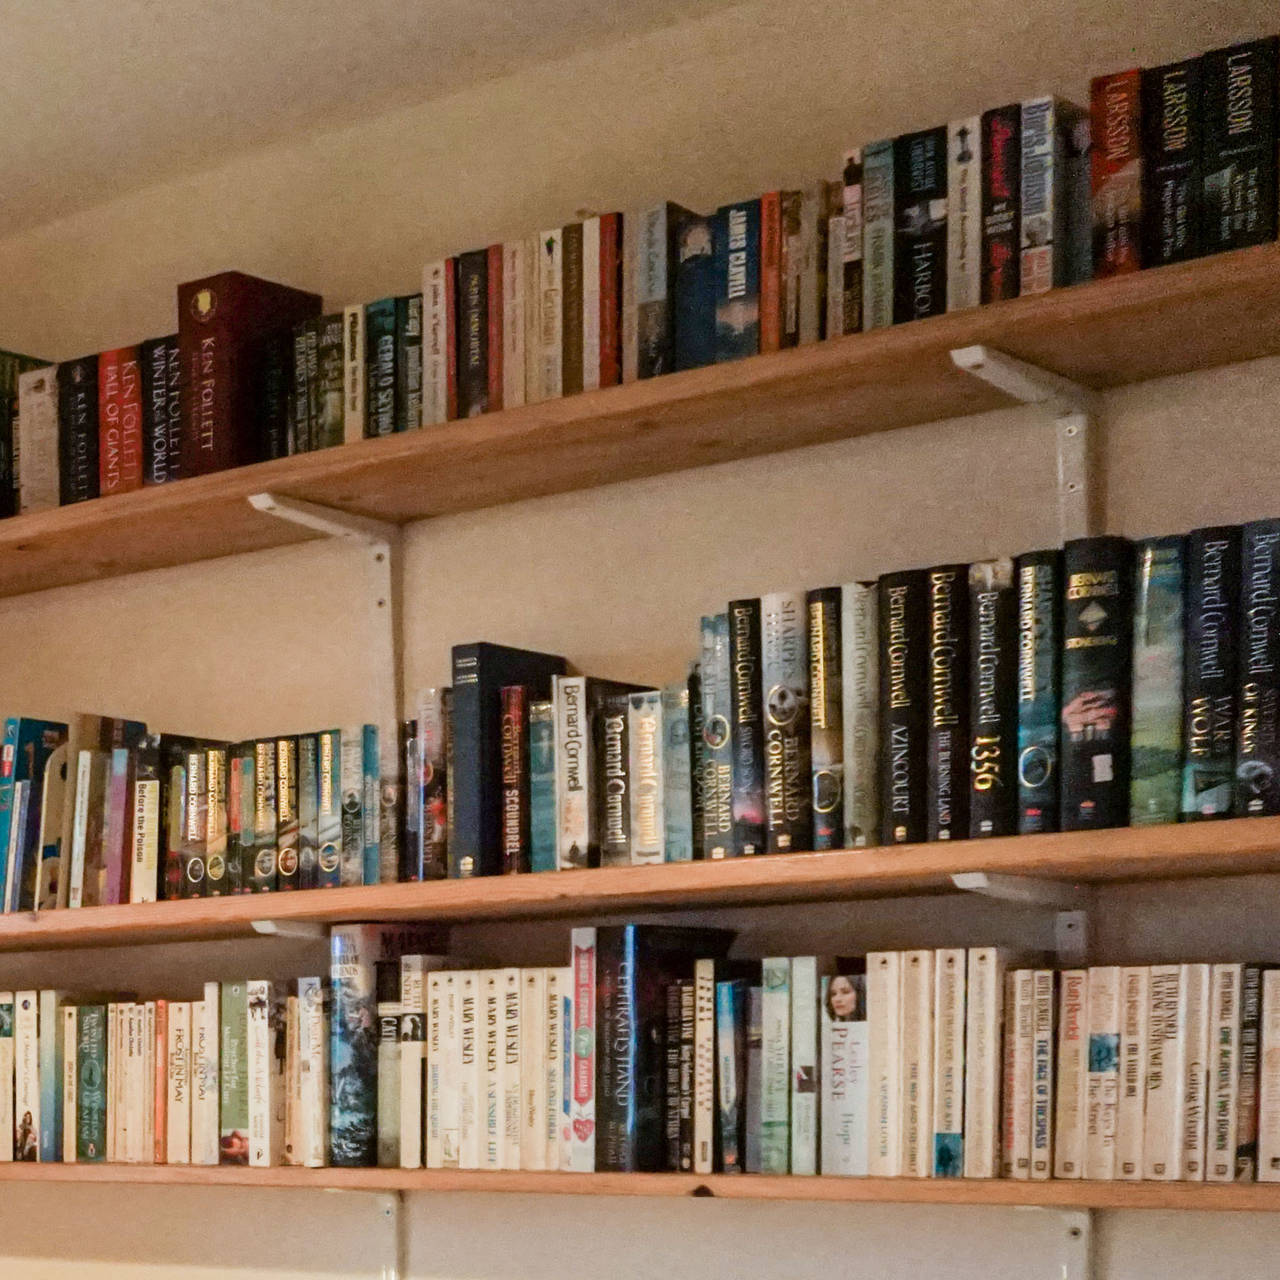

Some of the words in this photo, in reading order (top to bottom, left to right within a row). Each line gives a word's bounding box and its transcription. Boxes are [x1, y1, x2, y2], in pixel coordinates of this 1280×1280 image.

[1227, 52, 1255, 136] LARSSON
[152, 344, 167, 411] WINTER
[201, 336, 216, 375] KEN
[200, 379, 215, 452] FOLLETT
[152, 424, 167, 484] WORLD
[1201, 538, 1230, 606] Bernard
[889, 585, 910, 642] Bernard
[931, 572, 960, 645] Bernard
[977, 592, 1001, 651] Bernard
[1200, 611, 1225, 679] Cornwell
[1247, 606, 1276, 674] Cornwell
[888, 643, 912, 709] Cornwell
[932, 645, 959, 728] Cornwell
[977, 652, 1001, 724] Cornwell
[563, 684, 582, 738] Bernard
[564, 739, 584, 792] Cornwell
[767, 729, 784, 832] CORNWELL
[890, 723, 910, 816] AZINCOURT
[970, 735, 1001, 791] 1356
[137, 782, 148, 814] Before
[137, 814, 147, 831] the
[505, 789, 520, 856] SCOUNDREL
[135, 832, 147, 863] Poison
[462, 997, 475, 1024] MARY
[487, 996, 497, 1026] MARY
[505, 991, 519, 1021] MARY
[462, 1027, 475, 1065] WESLEY
[487, 1030, 497, 1072] WESLEY
[505, 1024, 519, 1065] WESLEY
[831, 1027, 849, 1100] PEARSE
[614, 1056, 632, 1106] HAND
[1089, 1102, 1102, 1136] Street
